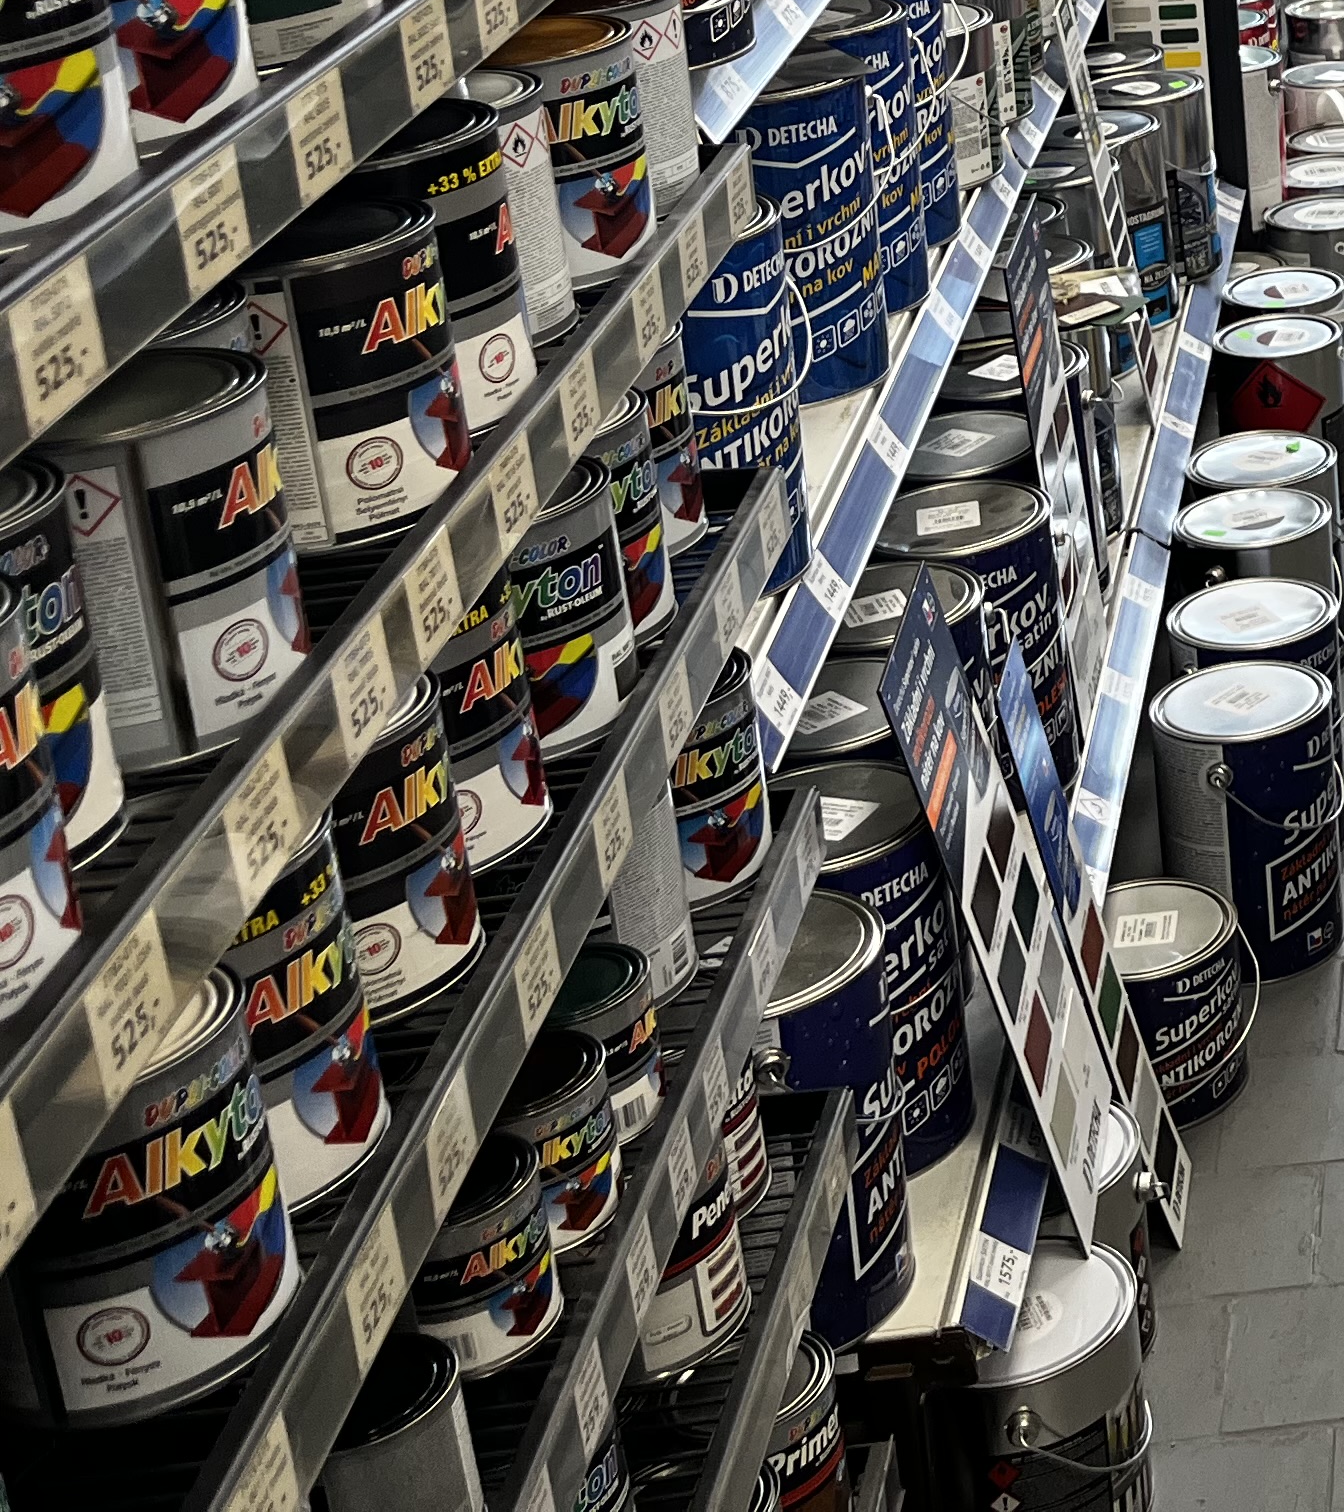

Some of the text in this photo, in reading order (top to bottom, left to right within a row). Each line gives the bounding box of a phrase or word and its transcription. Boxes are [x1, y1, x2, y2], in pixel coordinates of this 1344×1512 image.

[767, 115, 838, 148] DETECHA
[427, 167, 477, 195] +33 %
[1189, 958, 1226, 992] DETECHA
